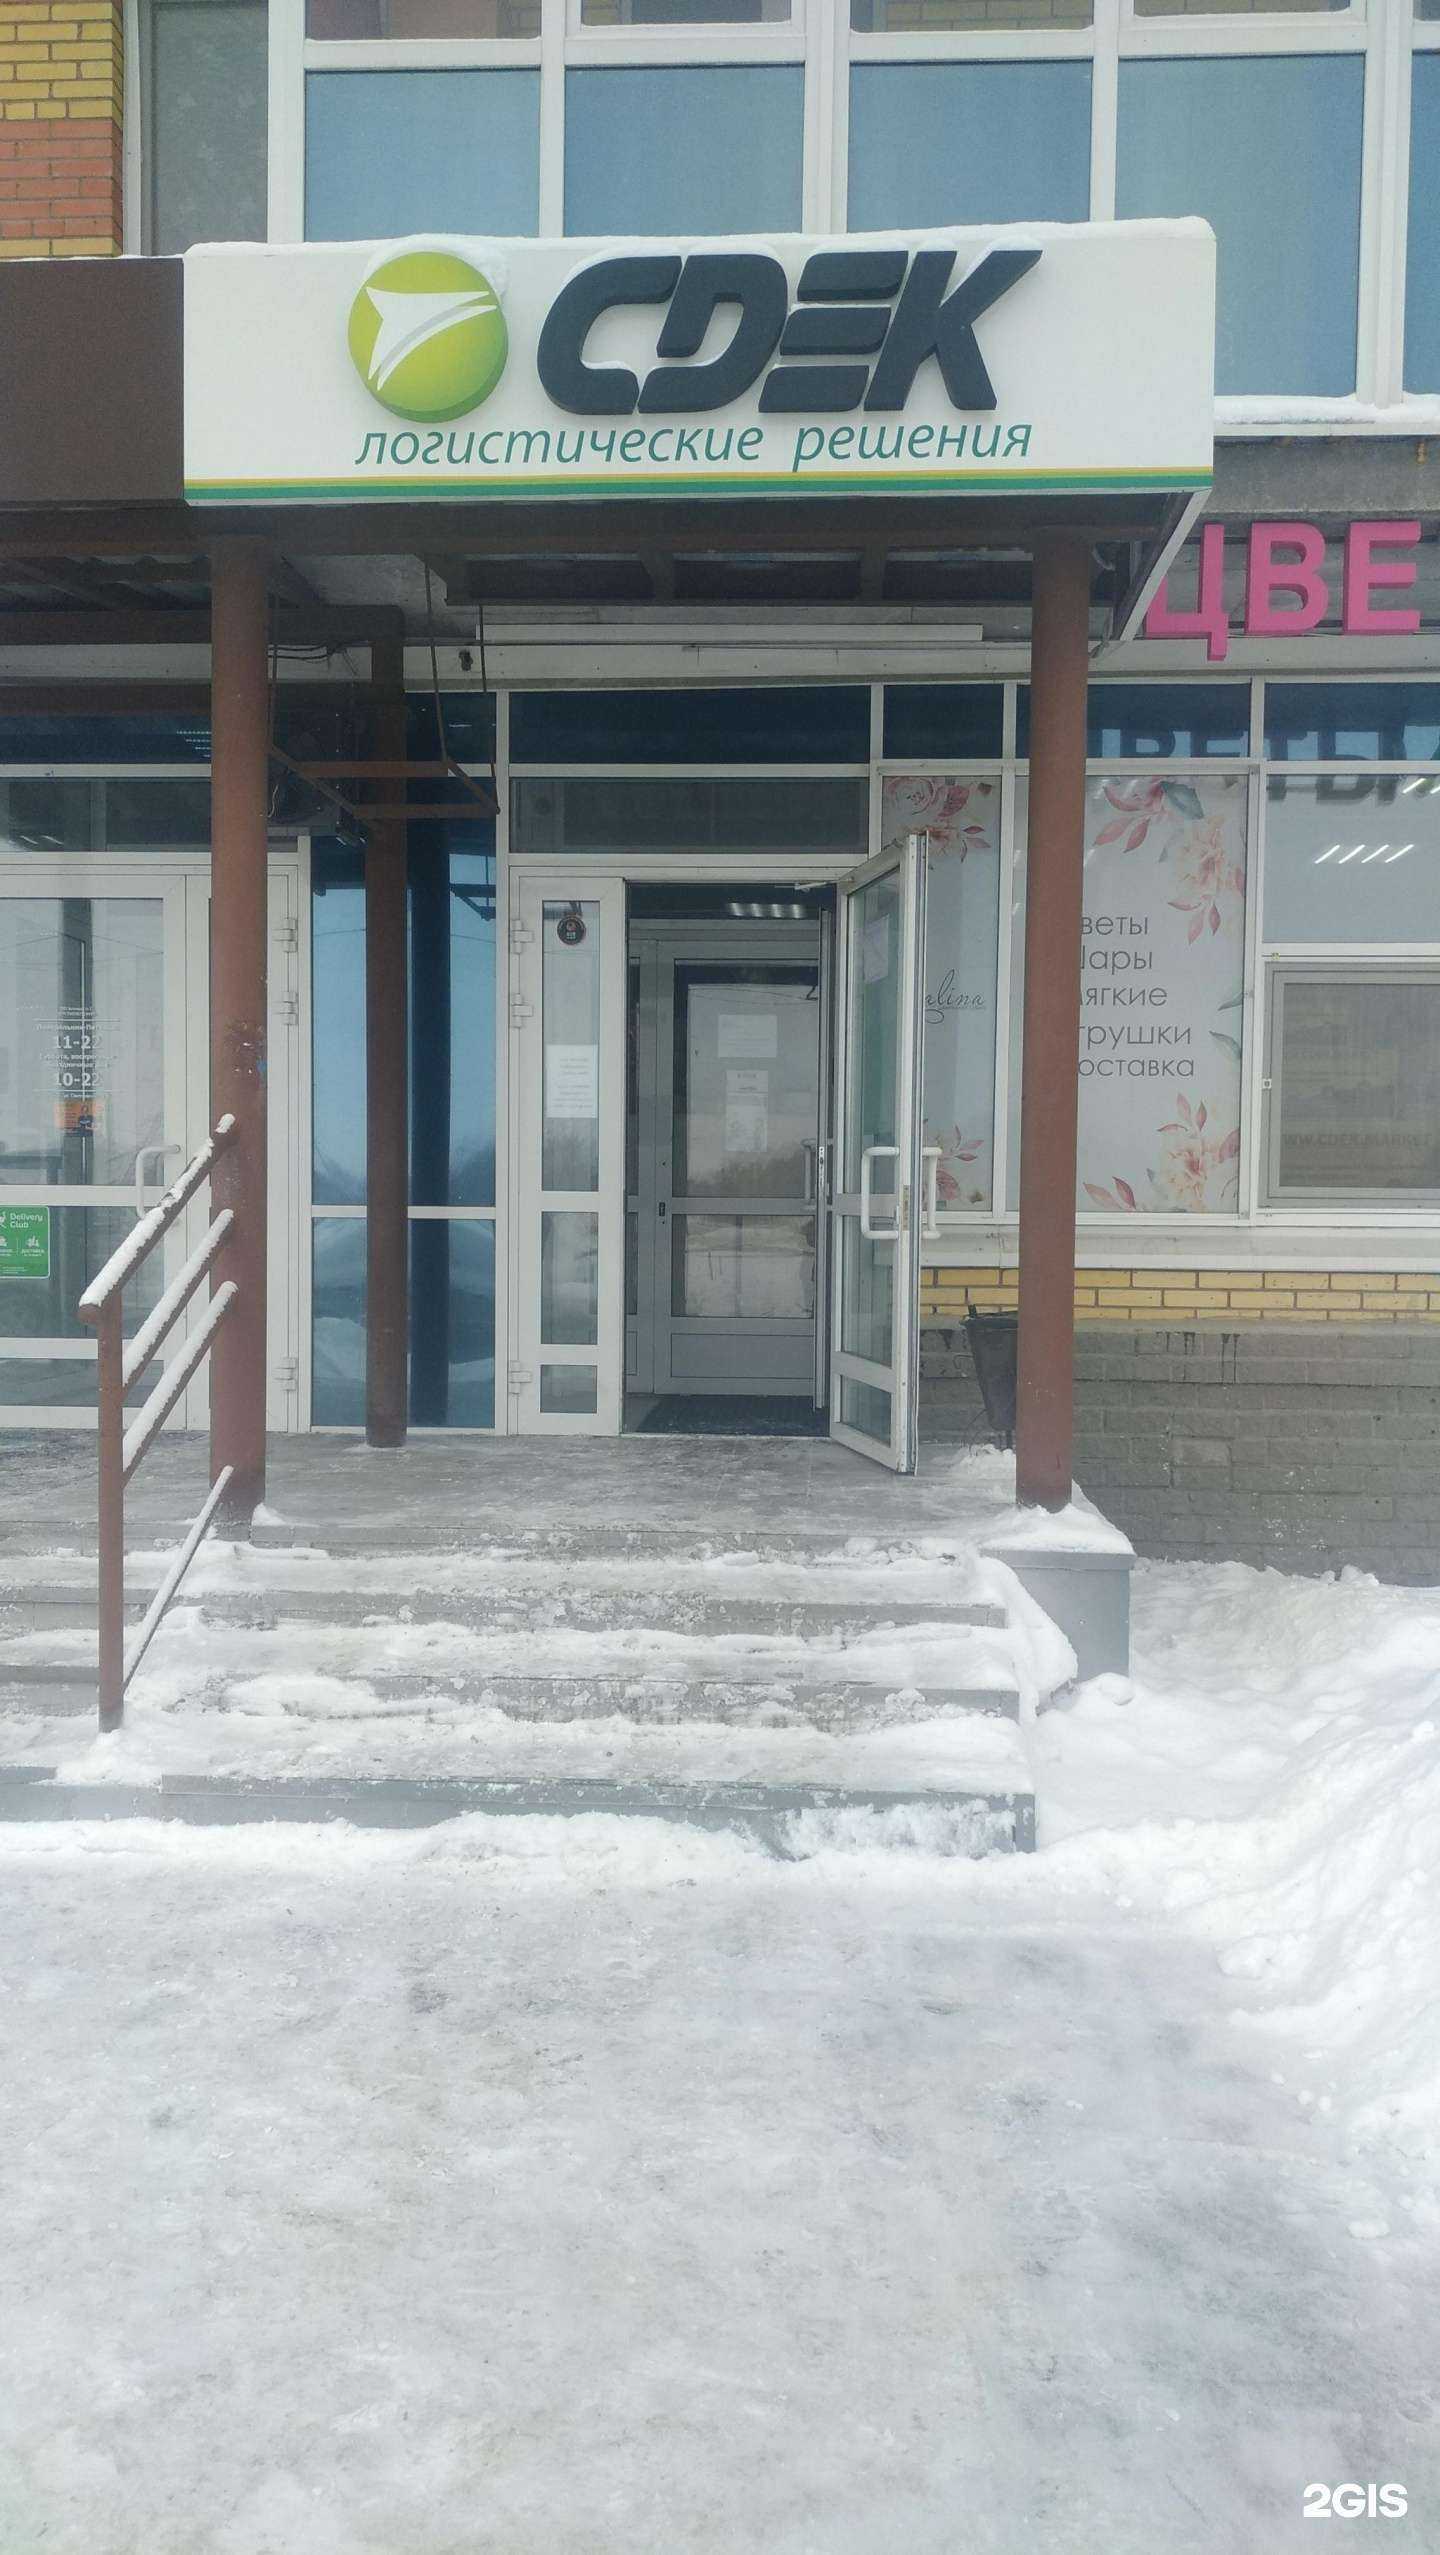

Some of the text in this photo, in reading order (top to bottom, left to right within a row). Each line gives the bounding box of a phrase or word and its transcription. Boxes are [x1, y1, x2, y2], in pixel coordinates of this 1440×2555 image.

[536, 250, 1043, 415] CDEK
[354, 422, 1032, 473] логистические решения
[1081, 916, 1149, 936] веты
[1081, 944, 1153, 976] ары
[925, 968, 986, 1025] alina
[1080, 986, 1168, 1007] ягкие
[1079, 1025, 1191, 1050] рушки
[1079, 1058, 1194, 1077] оставка
[9, 1212, 44, 1223] Delivery
[9, 1221, 30, 1229] Club
